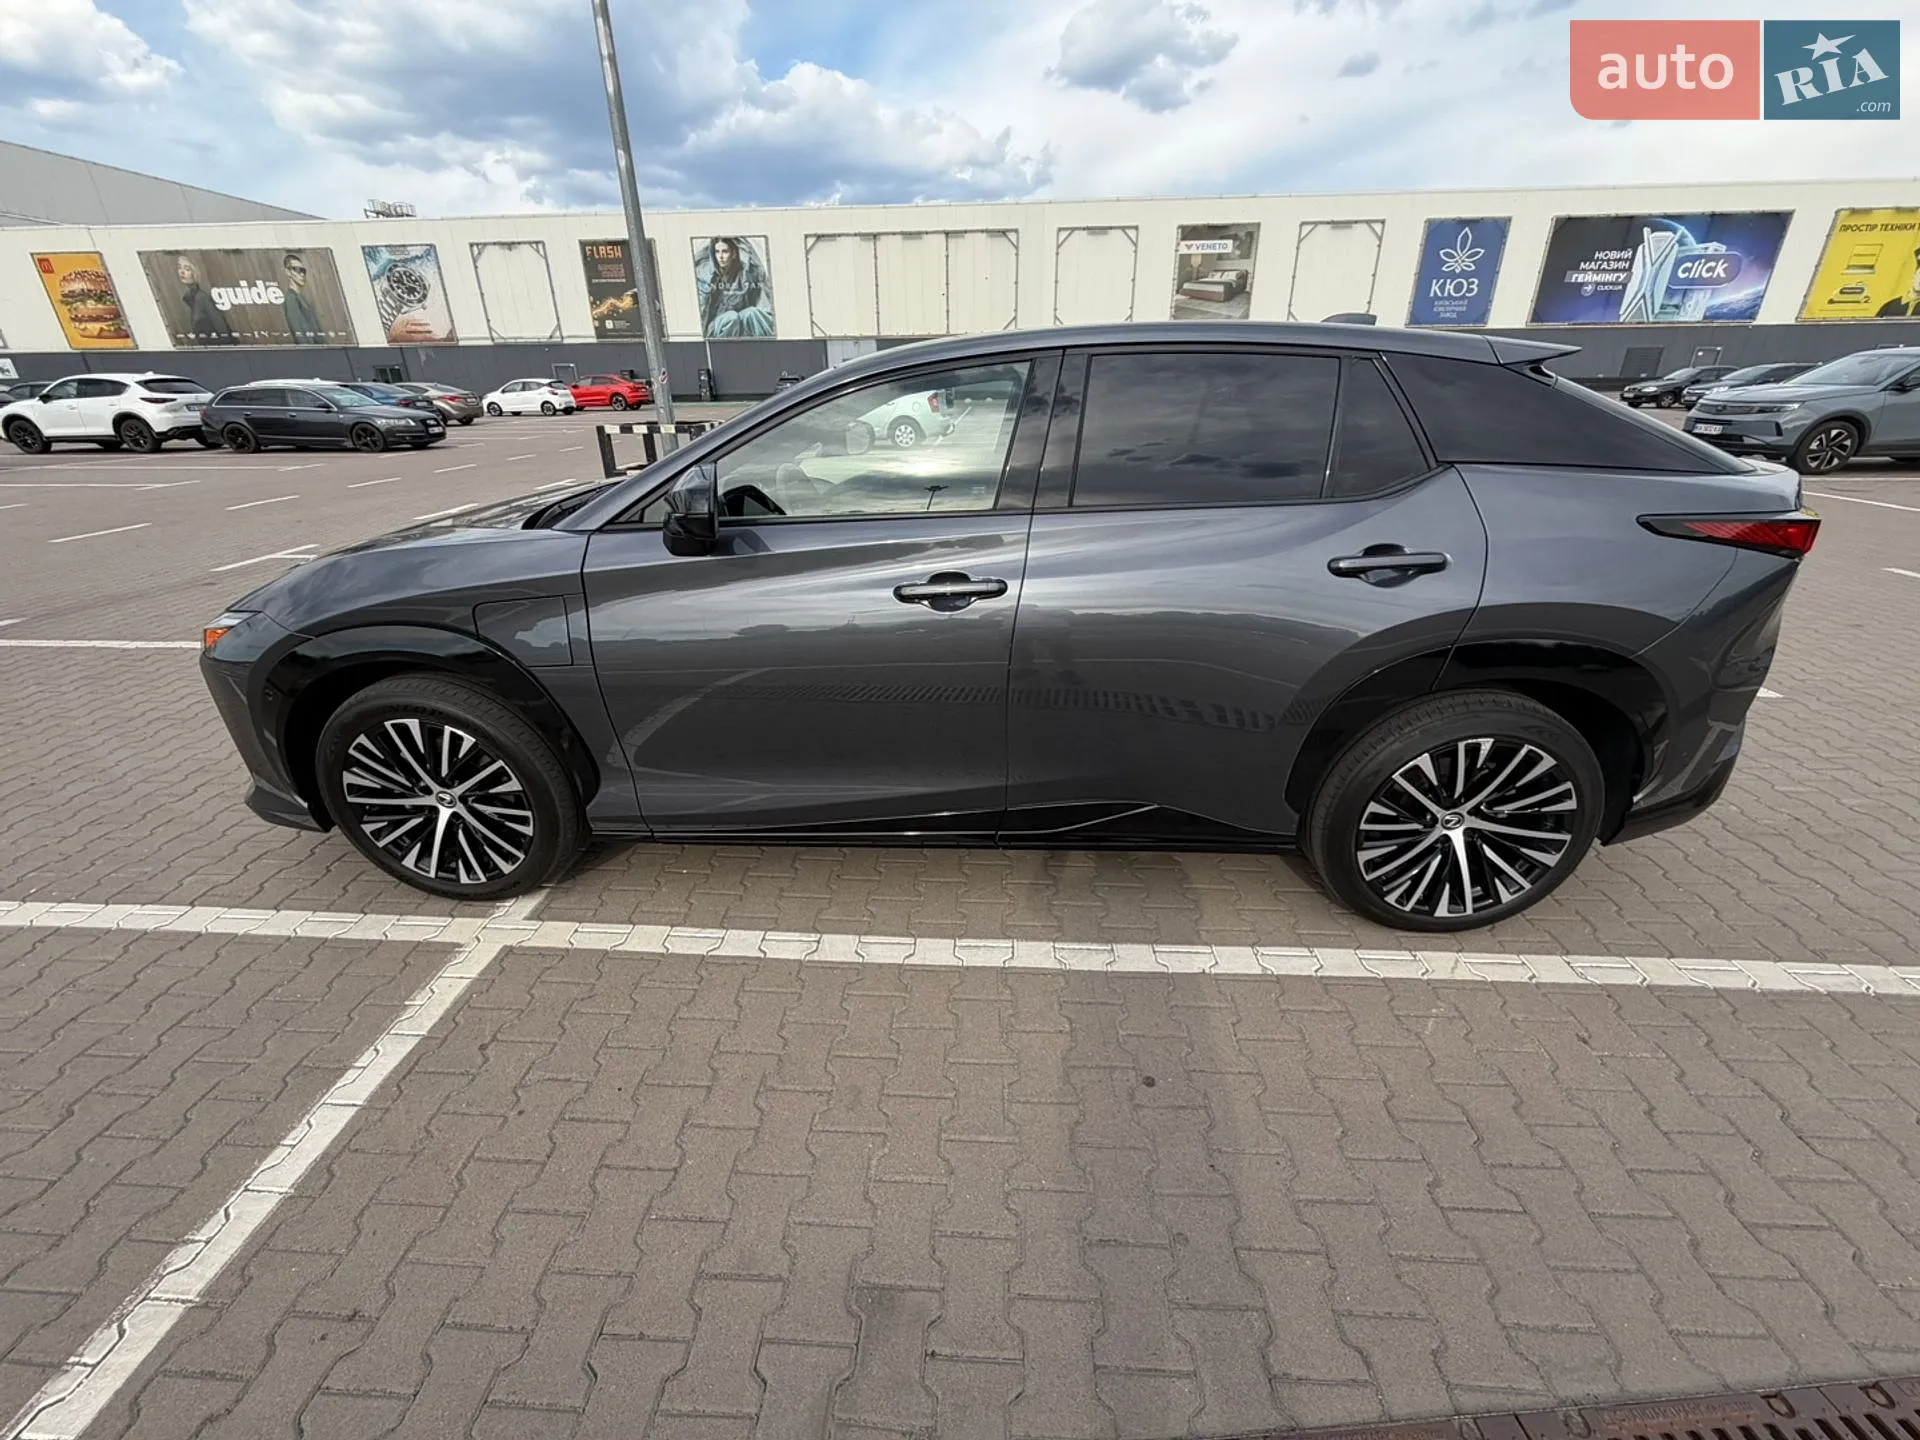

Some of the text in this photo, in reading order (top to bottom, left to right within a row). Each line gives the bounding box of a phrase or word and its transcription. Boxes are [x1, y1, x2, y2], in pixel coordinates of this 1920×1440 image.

[1195, 242, 1228, 251] VENETO
[1594, 248, 1633, 260] НОВИЙ
[1579, 261, 1630, 271] МАГАЗИН
[1571, 272, 1628, 283] ГЕЙМІНГУ
[1429, 278, 1479, 297] КЮЗ
[210, 279, 286, 311] guide
